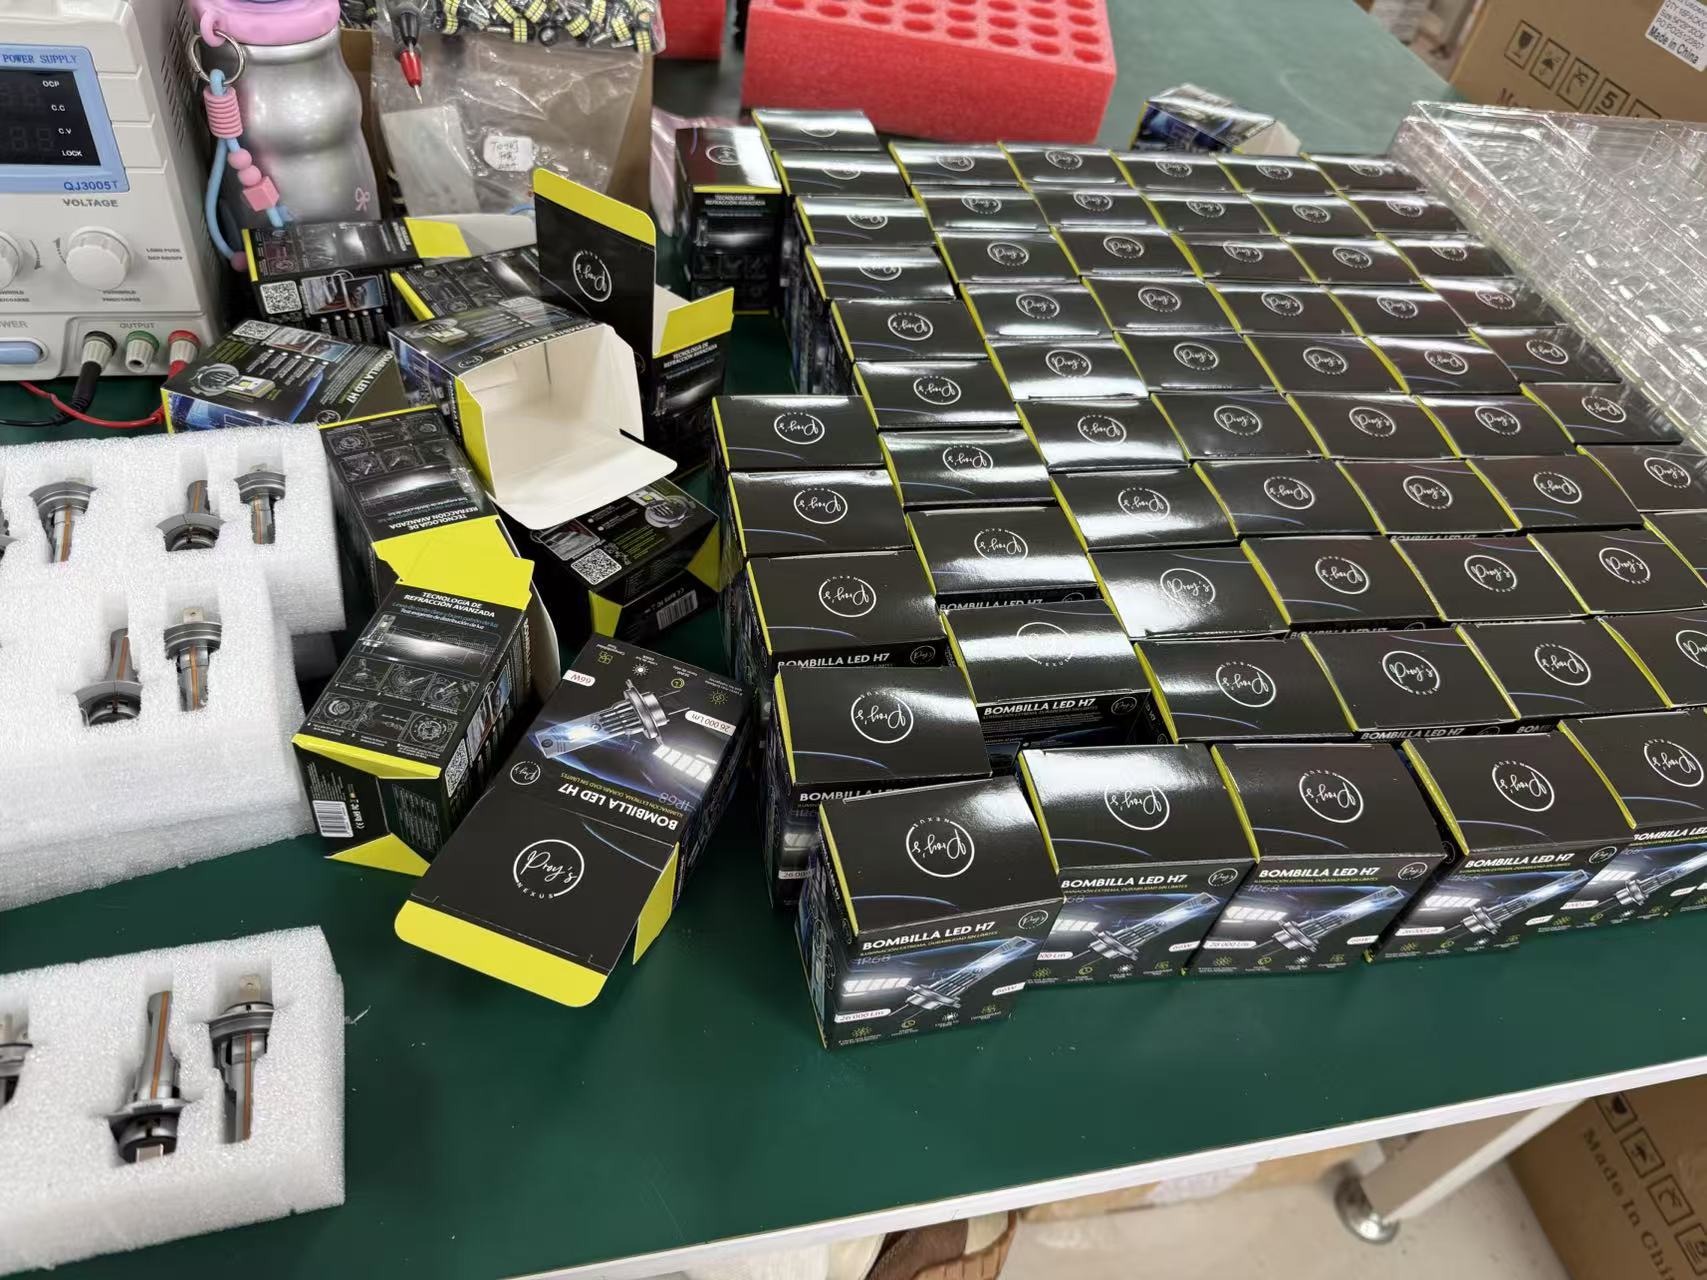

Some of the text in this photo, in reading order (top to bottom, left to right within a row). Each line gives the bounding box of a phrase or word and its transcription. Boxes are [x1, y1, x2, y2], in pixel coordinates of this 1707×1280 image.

[1648, 26, 1669, 45] Made
[1668, 38, 1677, 50] in
[1676, 44, 1699, 64] China
[2, 54, 77, 64] POWER SUPPLY
[42, 80, 60, 88] OCP
[51, 104, 66, 112] C.C
[64, 181, 118, 191] QJ3005T
[62, 198, 119, 208] VOLTAGE
[120, 322, 156, 330] OUTPUT
[355, 380, 370, 392] LED
[346, 392, 360, 404] H7
[389, 516, 430, 530] AVANZADA
[404, 594, 495, 618] REFRACCIÓN AVANZADA
[422, 592, 470, 606] TECNOLOGÍA
[847, 654, 871, 664] LED
[873, 652, 890, 662] H7
[570, 674, 592, 684] 66W
[984, 698, 1096, 716] BOMBILLA LED H7
[692, 714, 731, 732] 26 000 Lm
[1424, 728, 1448, 738] LED
[1448, 728, 1465, 737] H7
[558, 782, 679, 830] BOMBILLA LED H7
[520, 850, 578, 883] Proy's
[1464, 856, 1530, 868] BOMBILLA
[1532, 854, 1556, 864] LED
[1557, 852, 1575, 862] H7
[1259, 866, 1380, 878] BOMBILLA LED H7
[1060, 874, 1188, 888] BOMBILLA LED H7
[517, 880, 554, 900] NEXUS
[862, 922, 996, 950] BOMBILLA LED H7
[1582, 1127, 1674, 1280] Made In Chi
